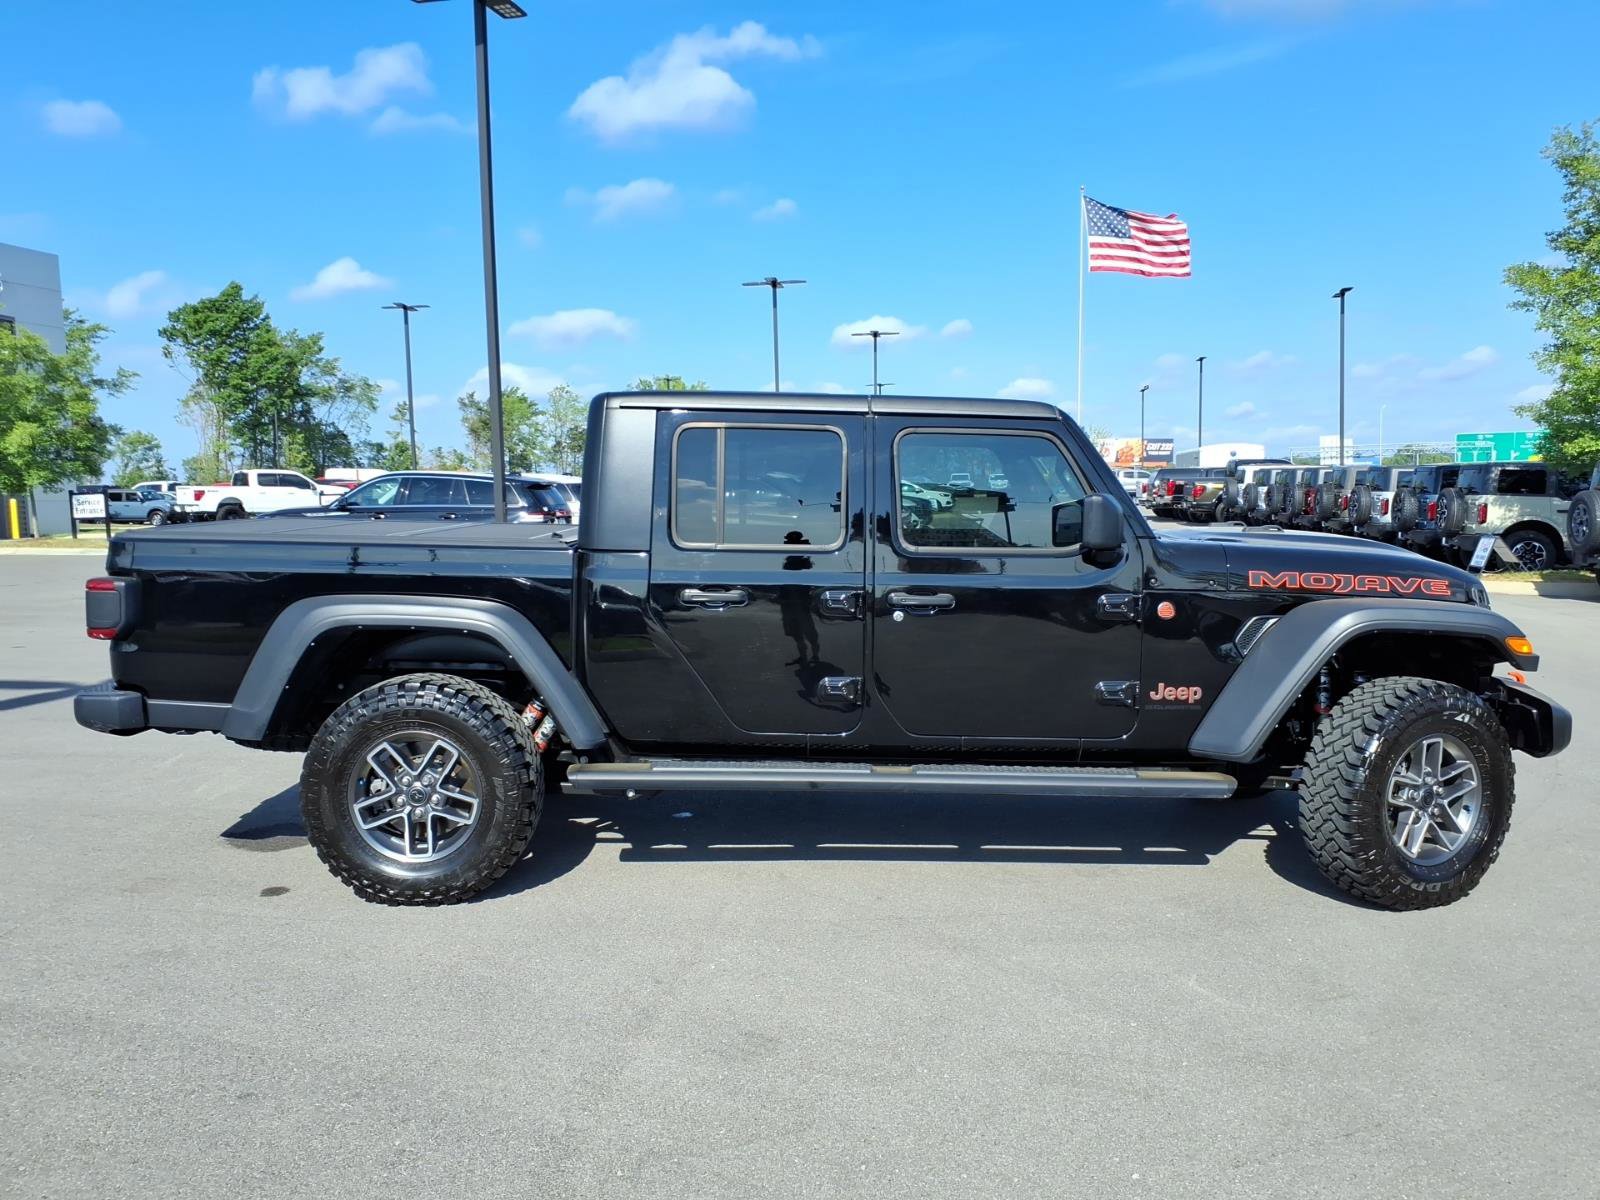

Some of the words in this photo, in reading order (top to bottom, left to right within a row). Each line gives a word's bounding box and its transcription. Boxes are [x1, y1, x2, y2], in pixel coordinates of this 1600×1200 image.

[76, 498, 101, 506] Service
[75, 507, 104, 515] Entrance
[1248, 570, 1451, 595] MOJAVE
[1149, 682, 1203, 704] Jeep
